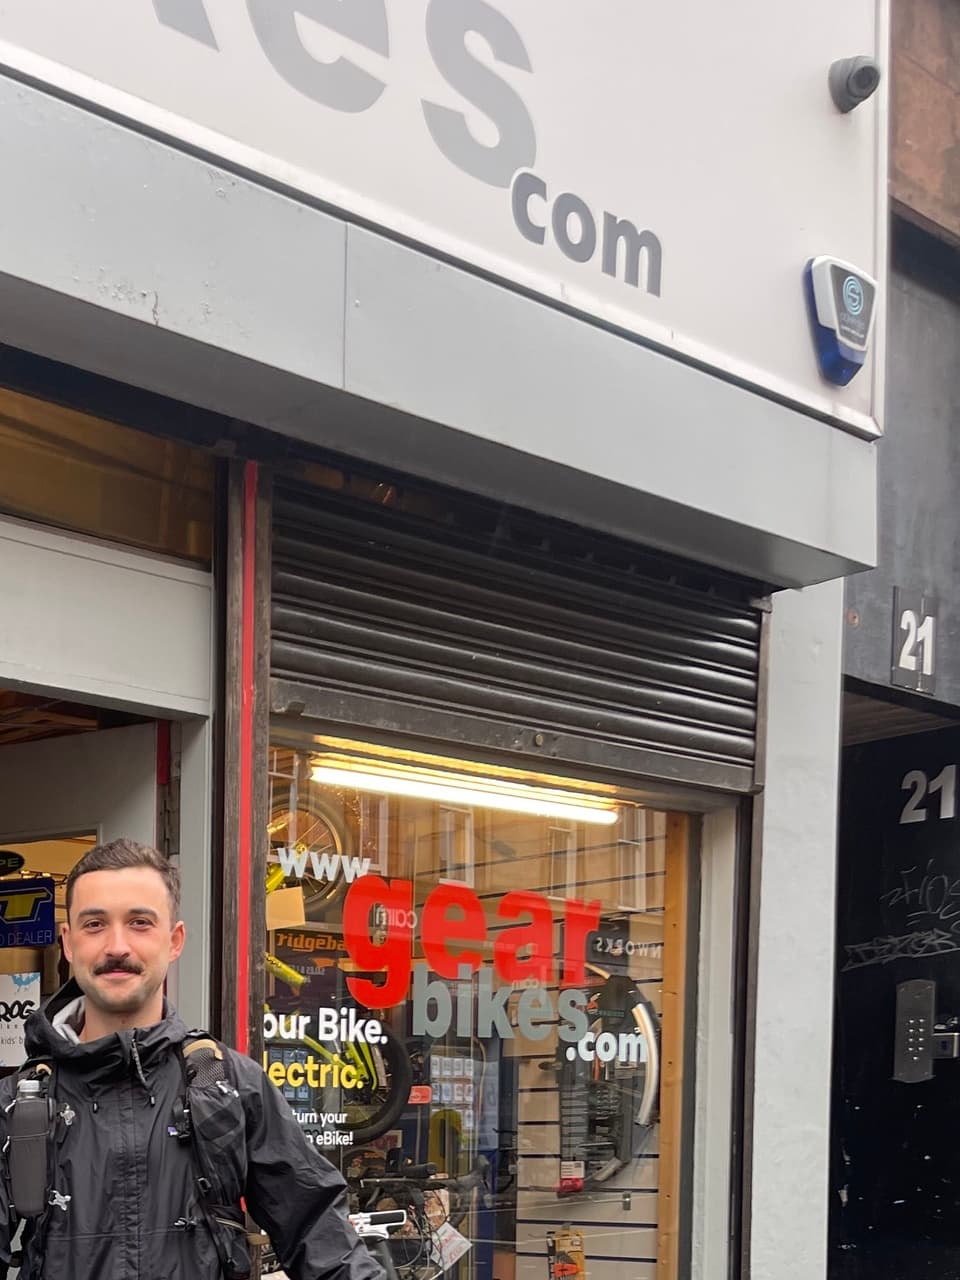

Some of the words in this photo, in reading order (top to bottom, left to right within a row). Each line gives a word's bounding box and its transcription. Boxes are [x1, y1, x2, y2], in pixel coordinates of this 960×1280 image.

[899, 609, 936, 676] 21
[899, 763, 957, 825] 21
[277, 847, 372, 884] www
[7, 929, 53, 947] DEALER
[342, 873, 601, 1010] gear
[412, 962, 589, 1043] bikes
[318, 1007, 388, 1045] Bike.
[565, 1031, 649, 1063] .com
[316, 1130, 354, 1146] eBike!
[320, 1112, 348, 1127] your
